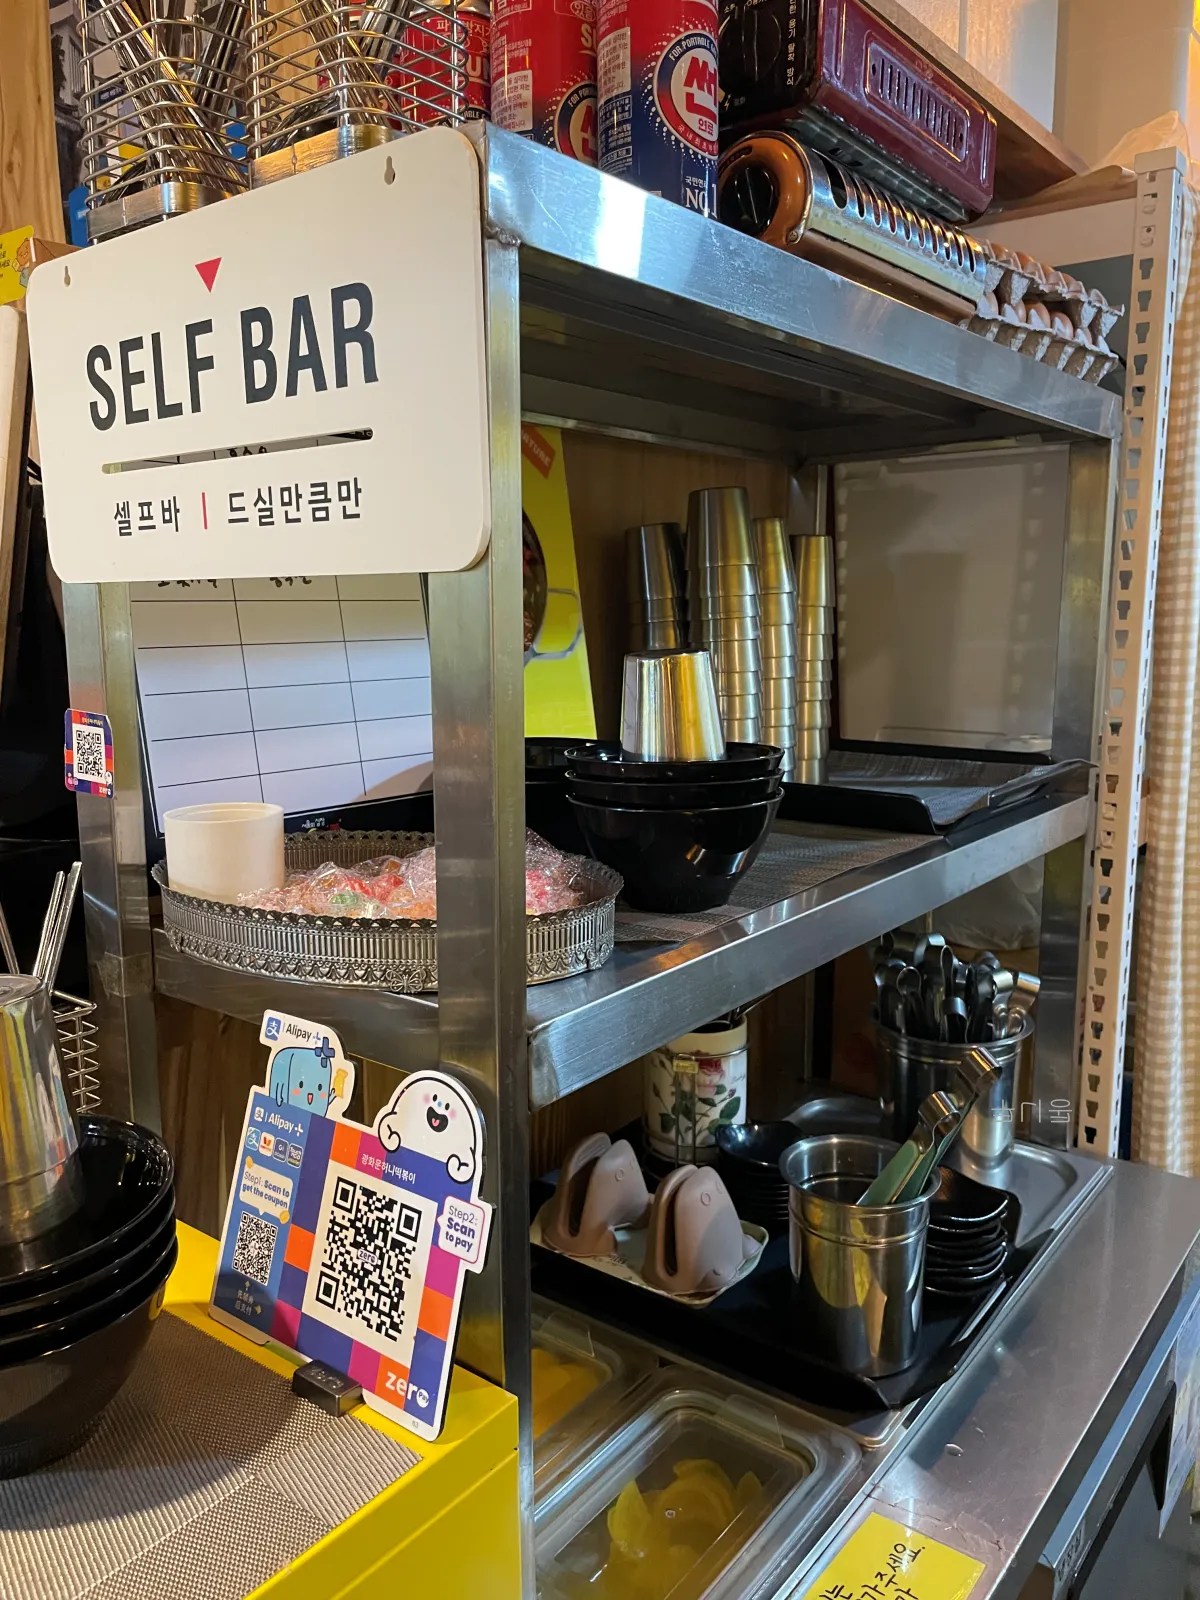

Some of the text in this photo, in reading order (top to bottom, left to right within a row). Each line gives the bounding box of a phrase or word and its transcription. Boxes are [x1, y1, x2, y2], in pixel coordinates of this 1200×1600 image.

[668, 45, 683, 61] FOR
[681, 36, 711, 51] PORTABLE
[568, 91, 580, 107] FOR
[698, 117, 715, 137] 연료
[86, 282, 379, 431] SELF BAR
[113, 477, 362, 537] 셀프바 드실만큼만
[361, 1153, 416, 1185] 광화문허니떡볶이
[242, 1183, 288, 1209] get the coupon
[263, 1179, 282, 1195] Scan
[282, 1188, 290, 1198] to
[448, 1205, 478, 1226] Step2:
[446, 1217, 476, 1239] Scan
[445, 1231, 473, 1253] to pay
